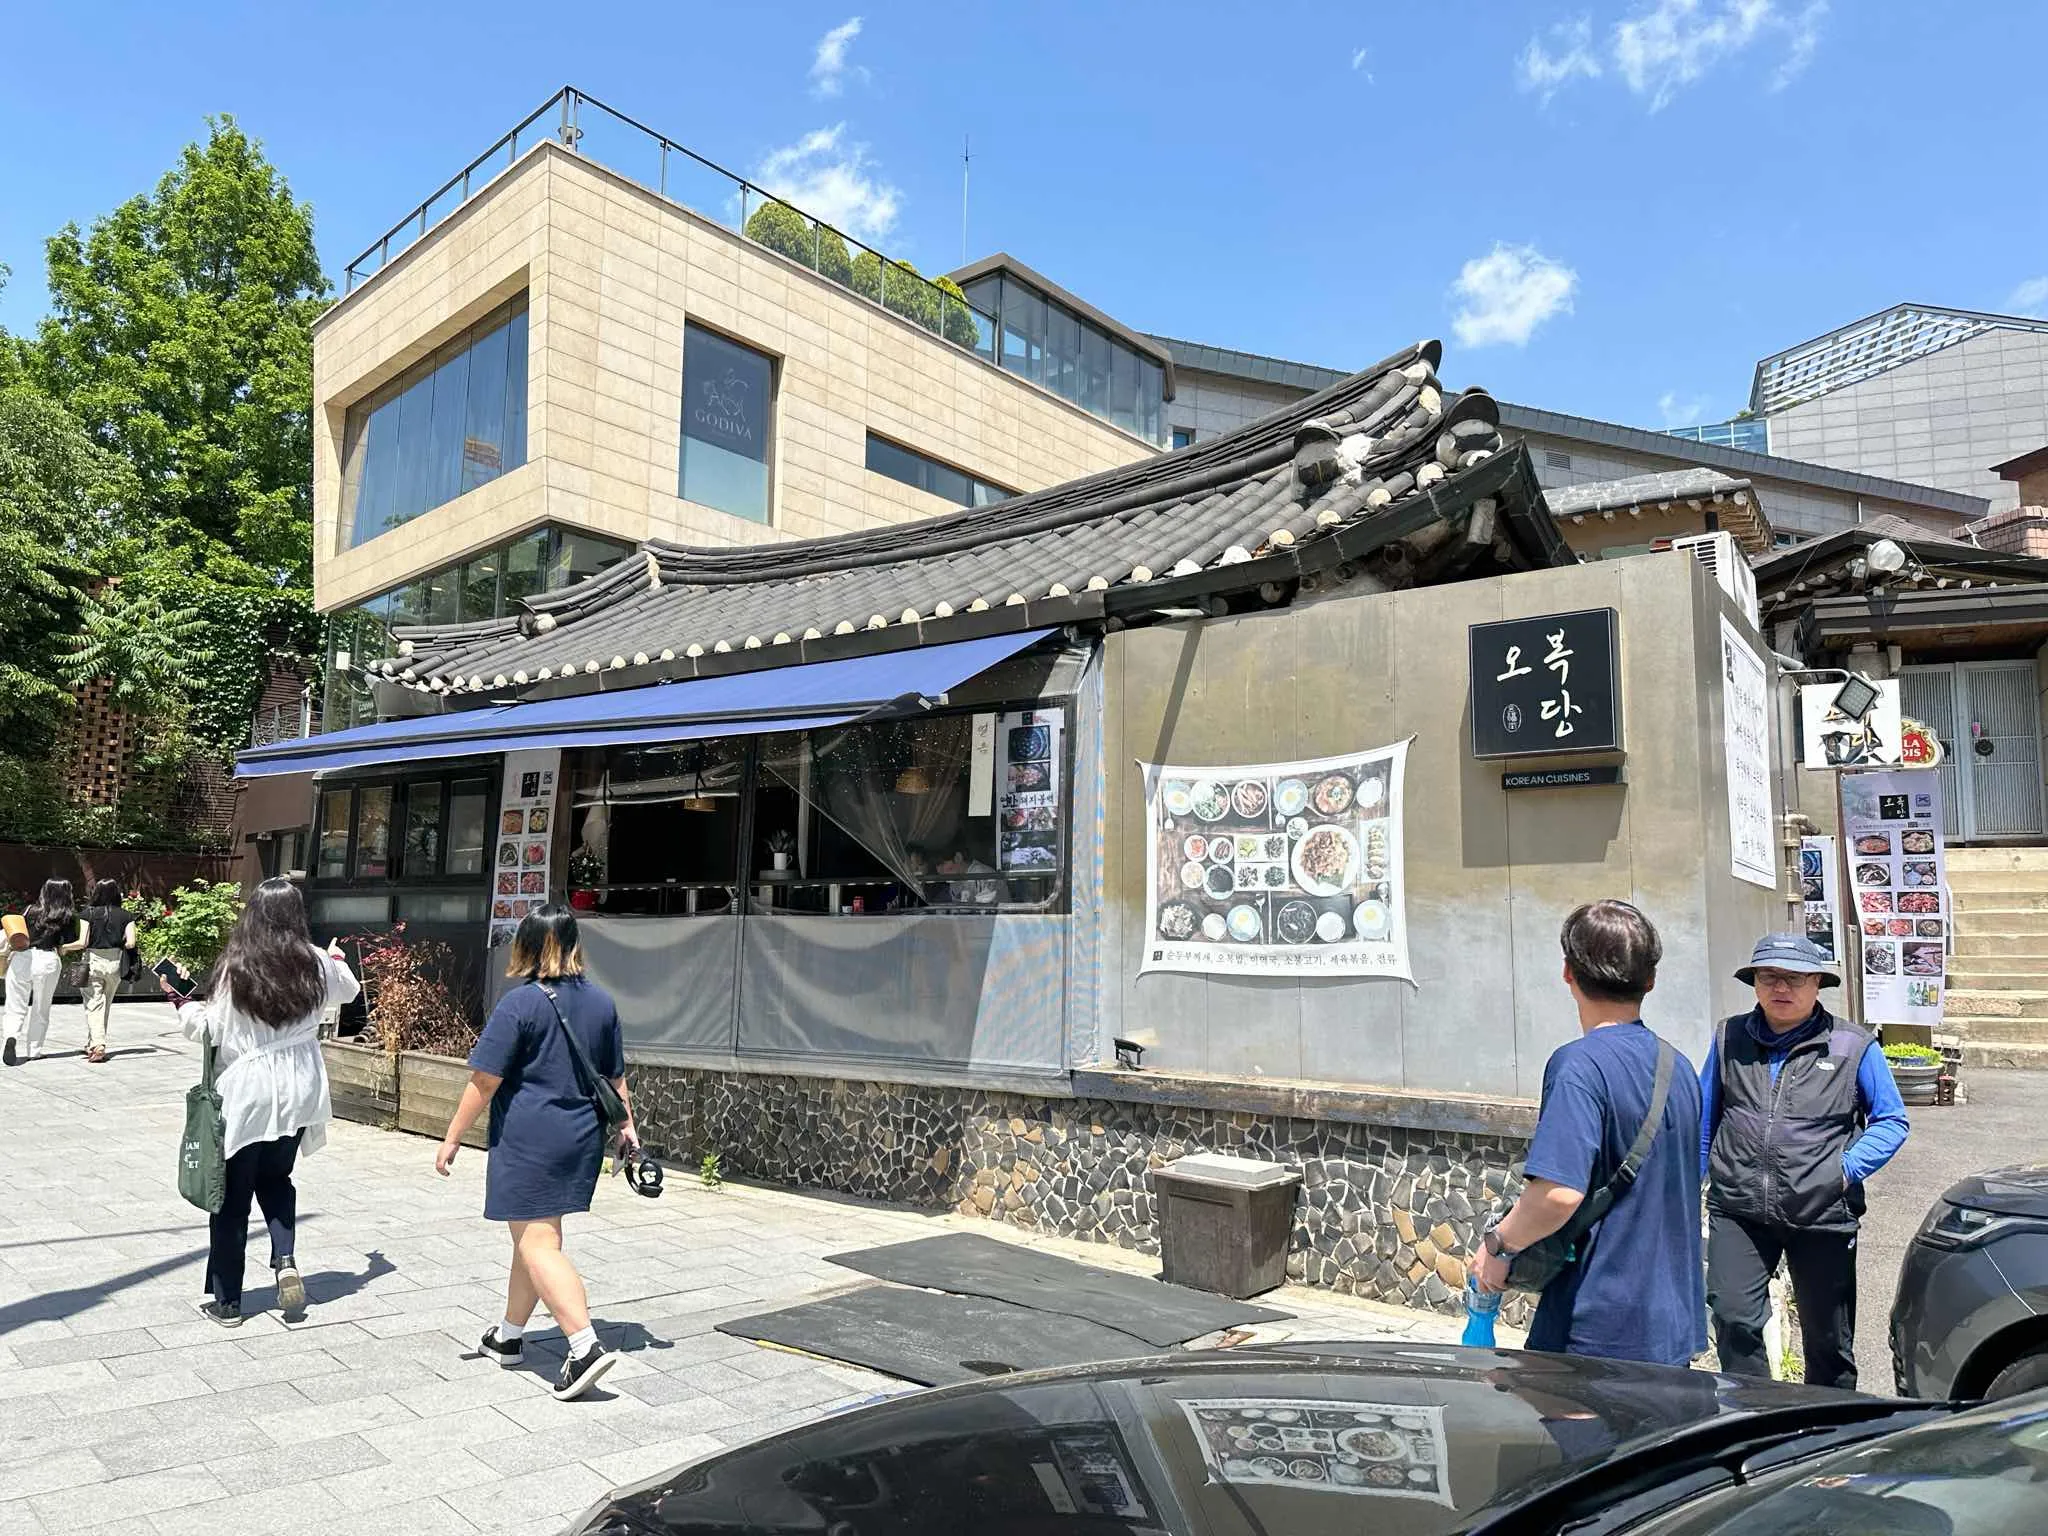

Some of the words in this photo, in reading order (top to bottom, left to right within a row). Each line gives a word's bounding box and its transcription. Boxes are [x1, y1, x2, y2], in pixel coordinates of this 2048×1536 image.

[695, 408, 752, 441] GODIVA
[1505, 776, 1544, 786] KOREAN
[1546, 773, 1590, 784] CUISINES
